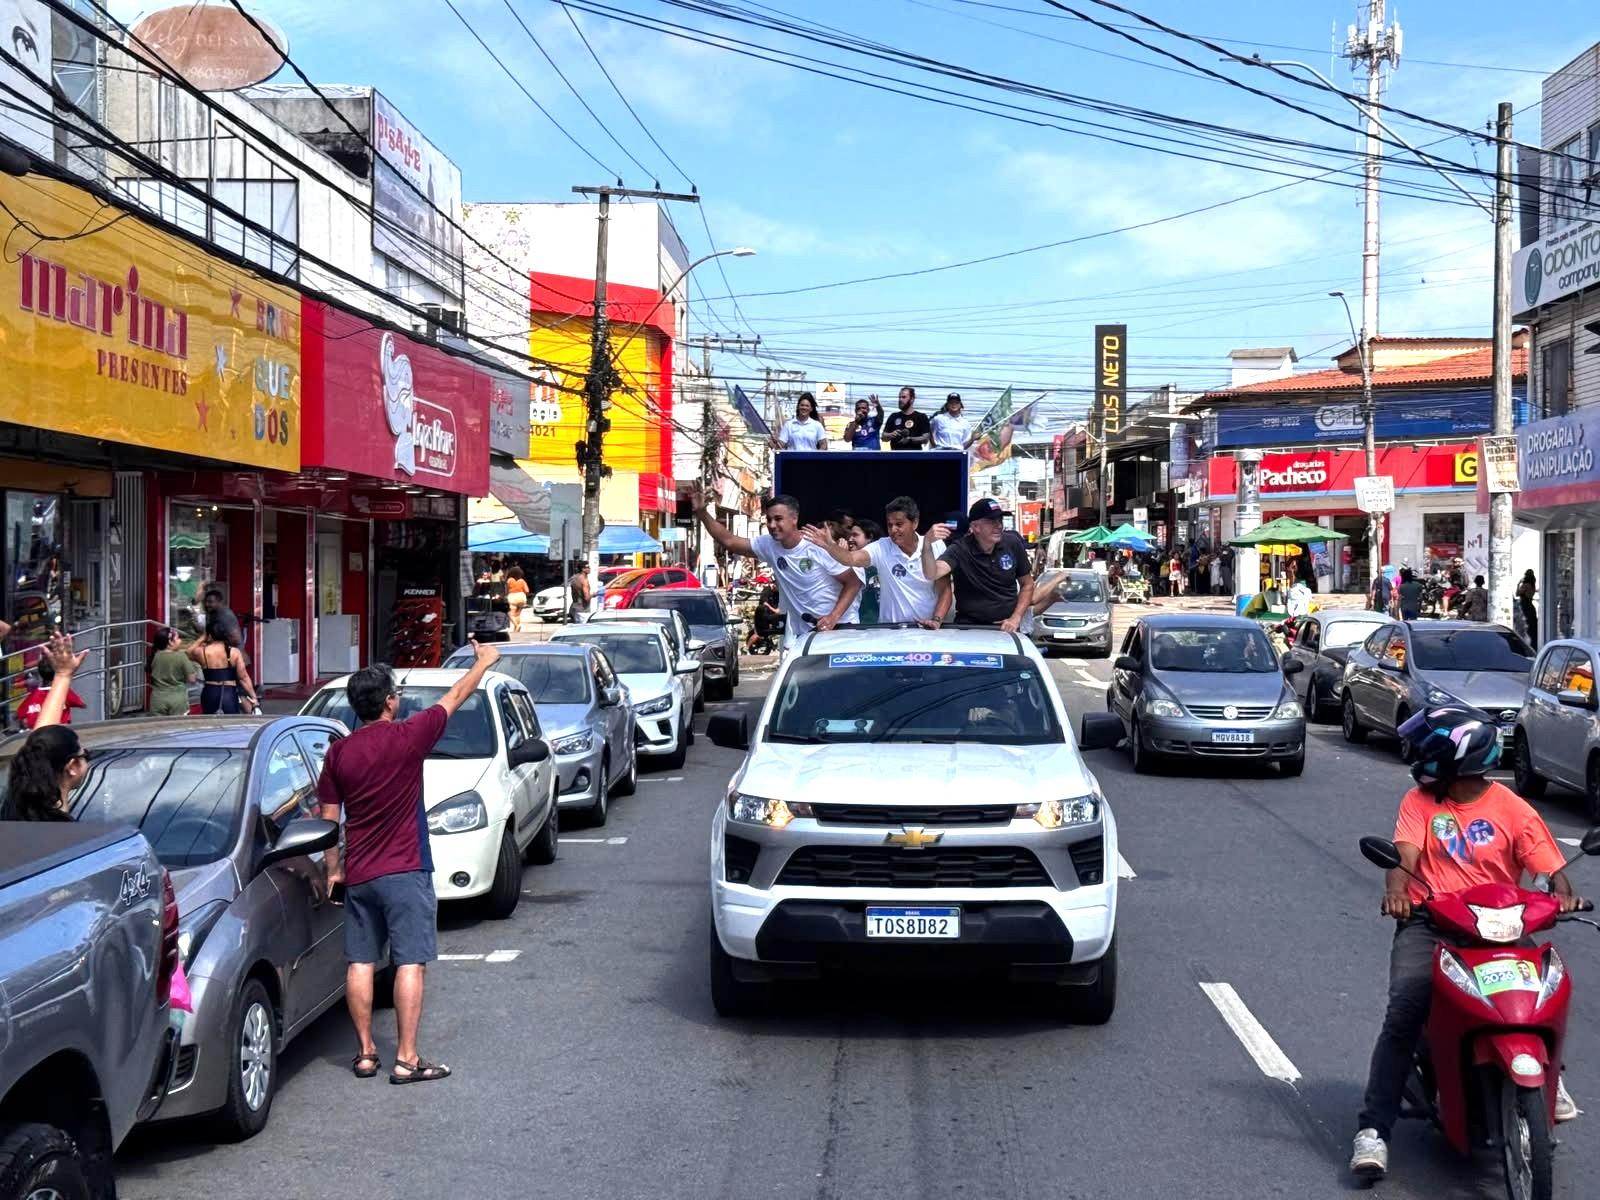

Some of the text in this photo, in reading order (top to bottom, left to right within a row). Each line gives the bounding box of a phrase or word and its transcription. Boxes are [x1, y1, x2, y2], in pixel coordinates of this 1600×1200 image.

[1544, 230, 1600, 276] ODONTO
[97, 349, 188, 396] PRESENTES
[1103, 336, 1119, 387] NETO
[254, 404, 288, 446] DOS
[1527, 426, 1574, 455] DROGARIA
[1259, 466, 1327, 486] Pacheco
[1527, 446, 1593, 480] MANIPULAÇÃO
[904, 652, 932, 662] 400
[120, 862, 150, 906] 4x4
[875, 917, 948, 934] TOS8D82
[1483, 970, 1515, 985] 2026
